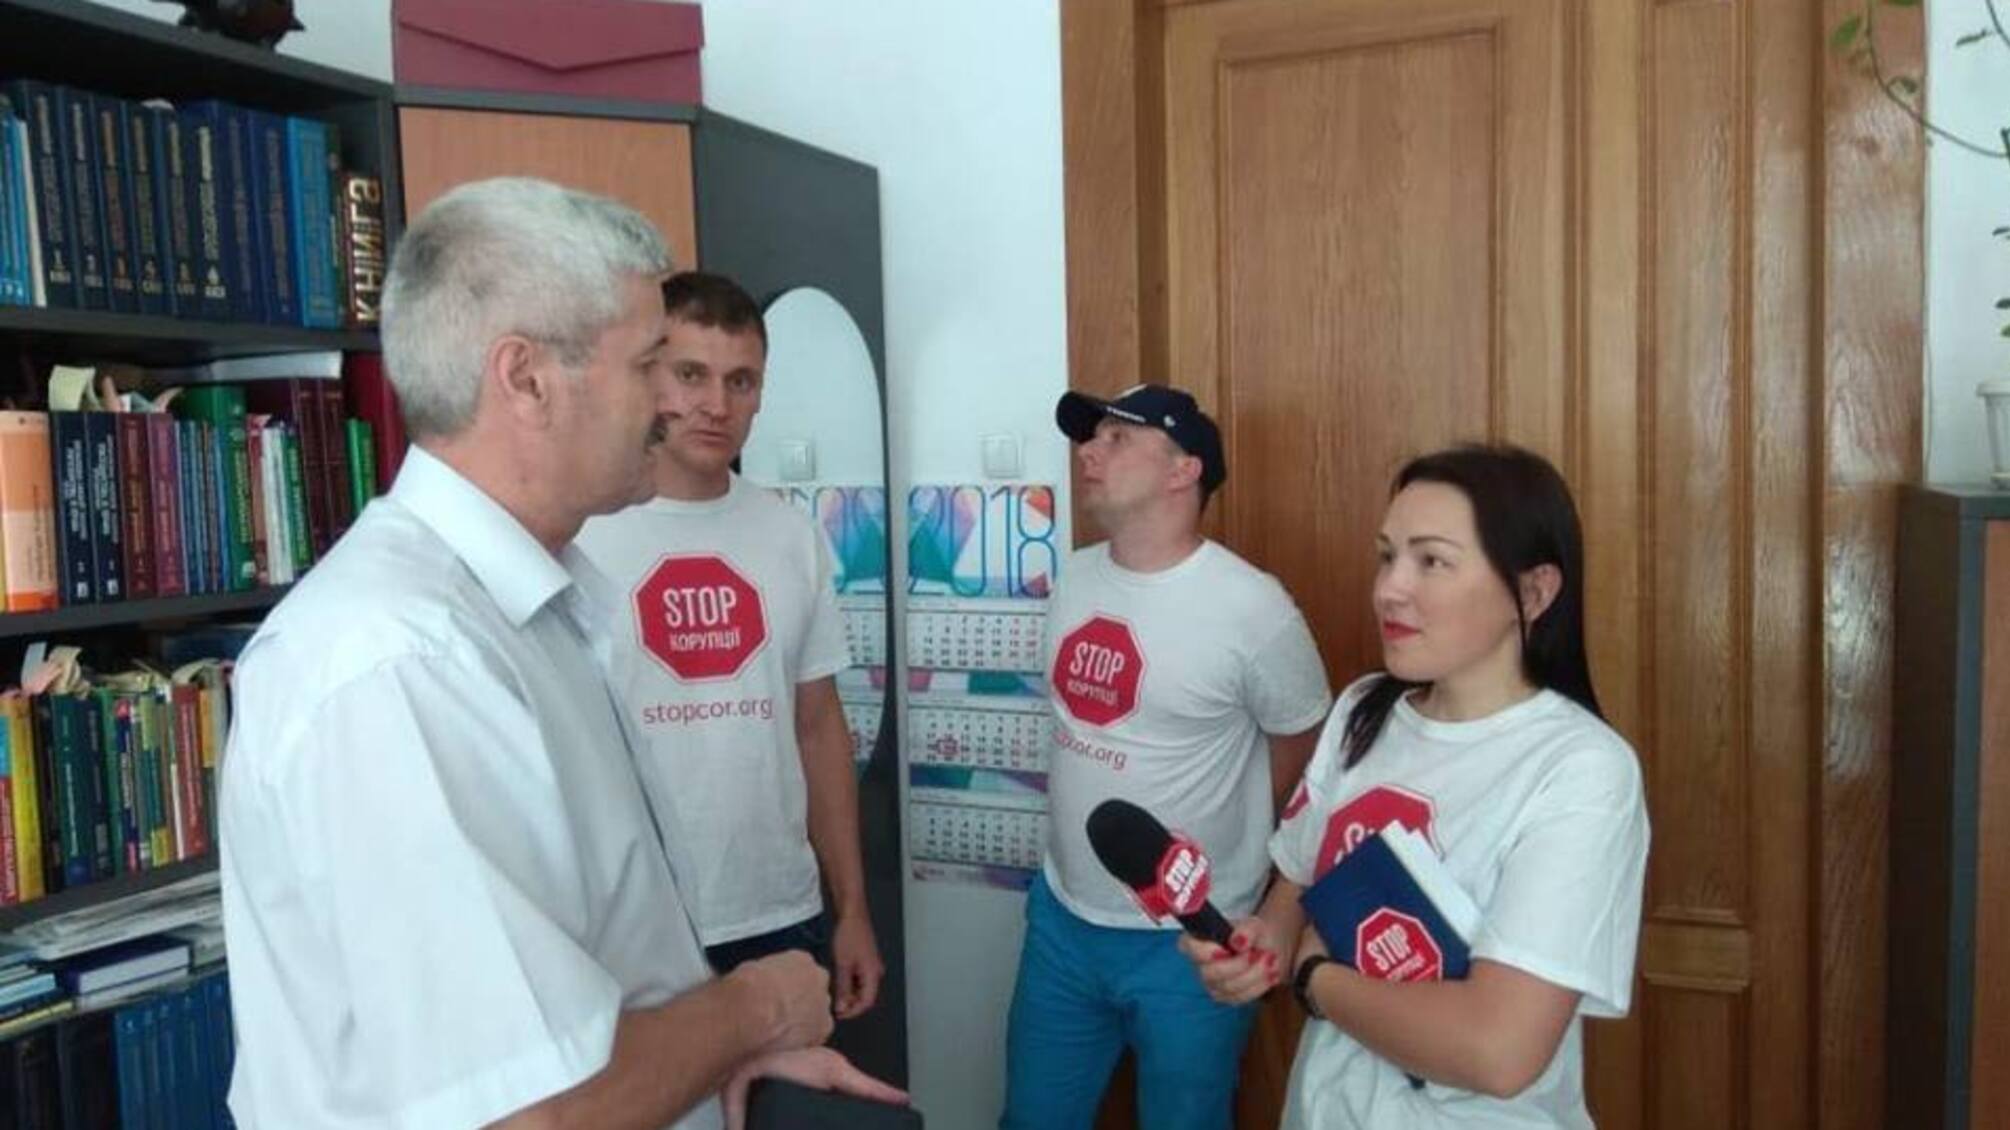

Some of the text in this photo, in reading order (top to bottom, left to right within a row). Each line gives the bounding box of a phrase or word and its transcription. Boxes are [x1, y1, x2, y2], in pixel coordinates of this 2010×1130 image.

[908, 484, 1057, 598] 2018
[663, 586, 737, 628] STOP
[1069, 641, 1125, 685] STOP
[642, 697, 773, 726] stopcor.org
[1366, 923, 1411, 971] STOP
